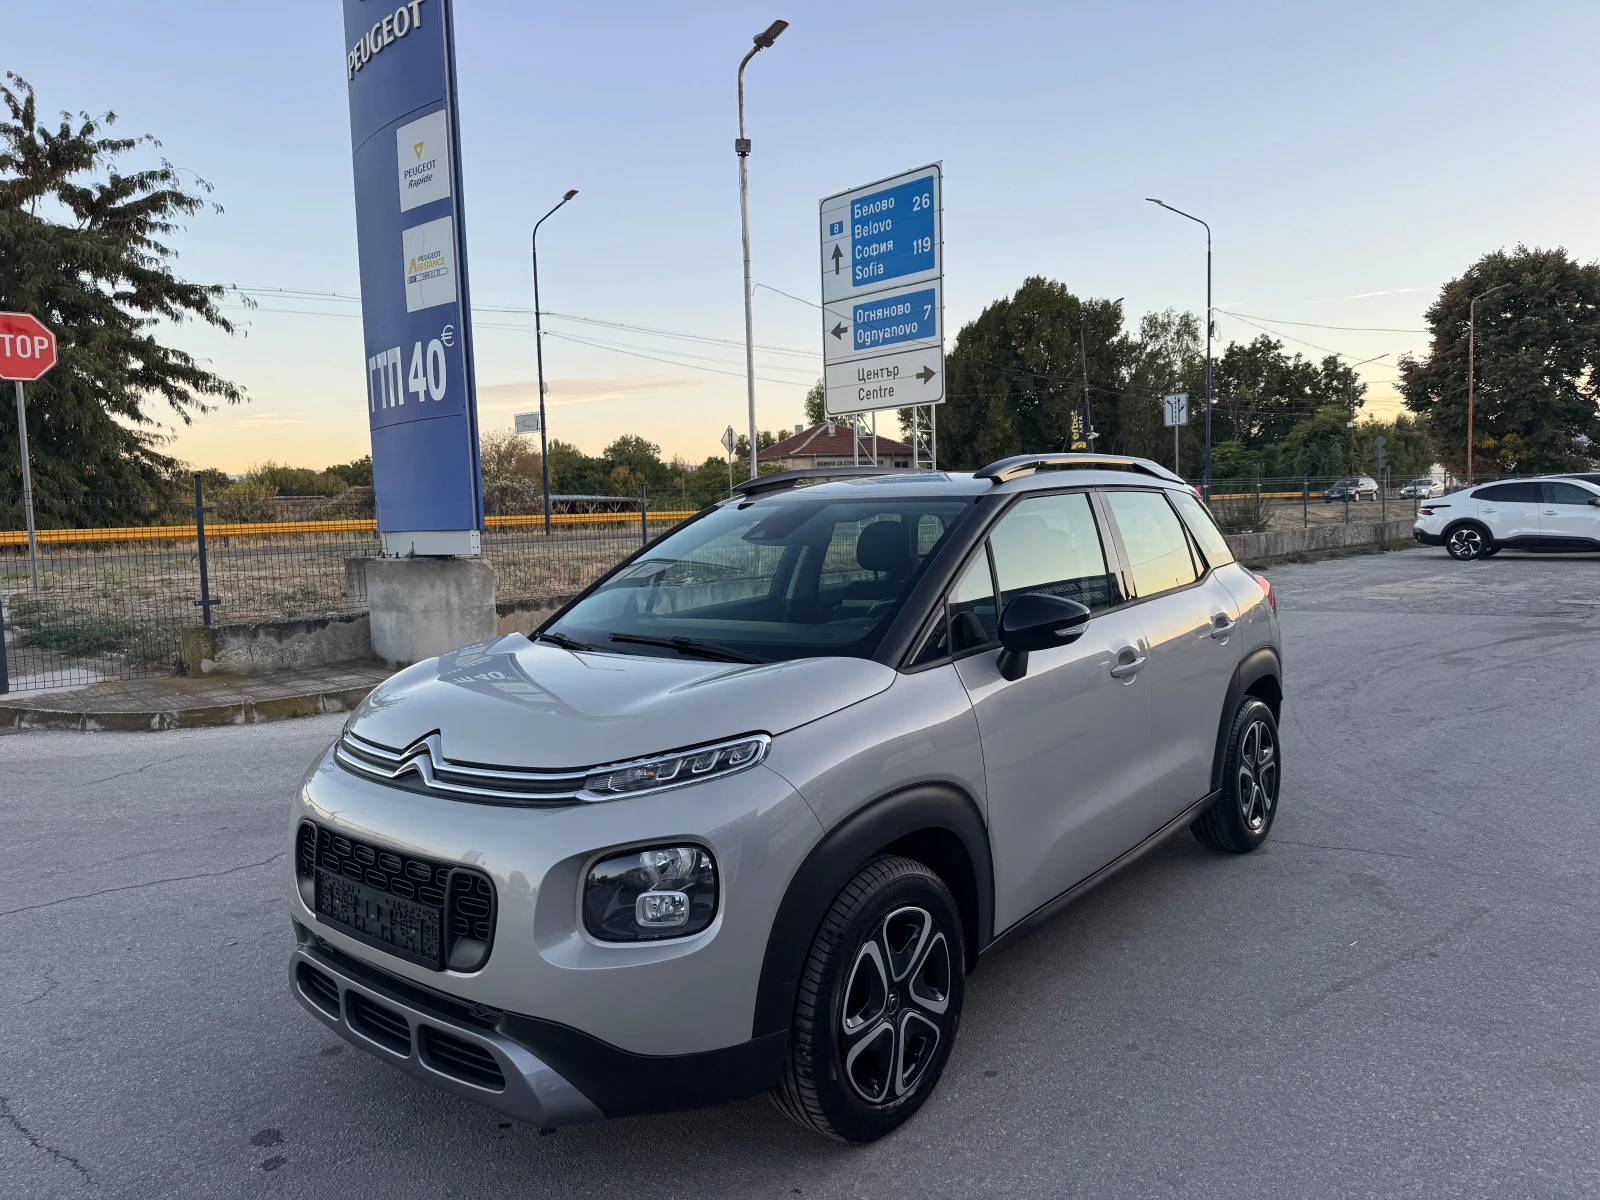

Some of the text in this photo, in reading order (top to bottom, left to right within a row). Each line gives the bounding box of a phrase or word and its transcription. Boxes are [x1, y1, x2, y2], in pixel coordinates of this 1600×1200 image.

[347, 0, 424, 80] PEUGEOT
[404, 159, 437, 179] PEUGEOT
[408, 173, 433, 189] Rapide
[854, 193, 930, 219] Белово 26
[833, 224, 839, 233] 8
[854, 218, 892, 239] Belovo
[417, 250, 441, 263] PEUGEOT
[855, 236, 931, 260] София 119
[855, 262, 884, 280] Sofia
[856, 302, 932, 324] Огняново 7
[857, 322, 918, 345] Ognyanovo
[0, 333, 49, 358] TOP
[368, 346, 404, 413] ГТП
[857, 364, 900, 383] Център
[858, 385, 895, 401] Centre
[1070, 410, 1079, 440] efbet
